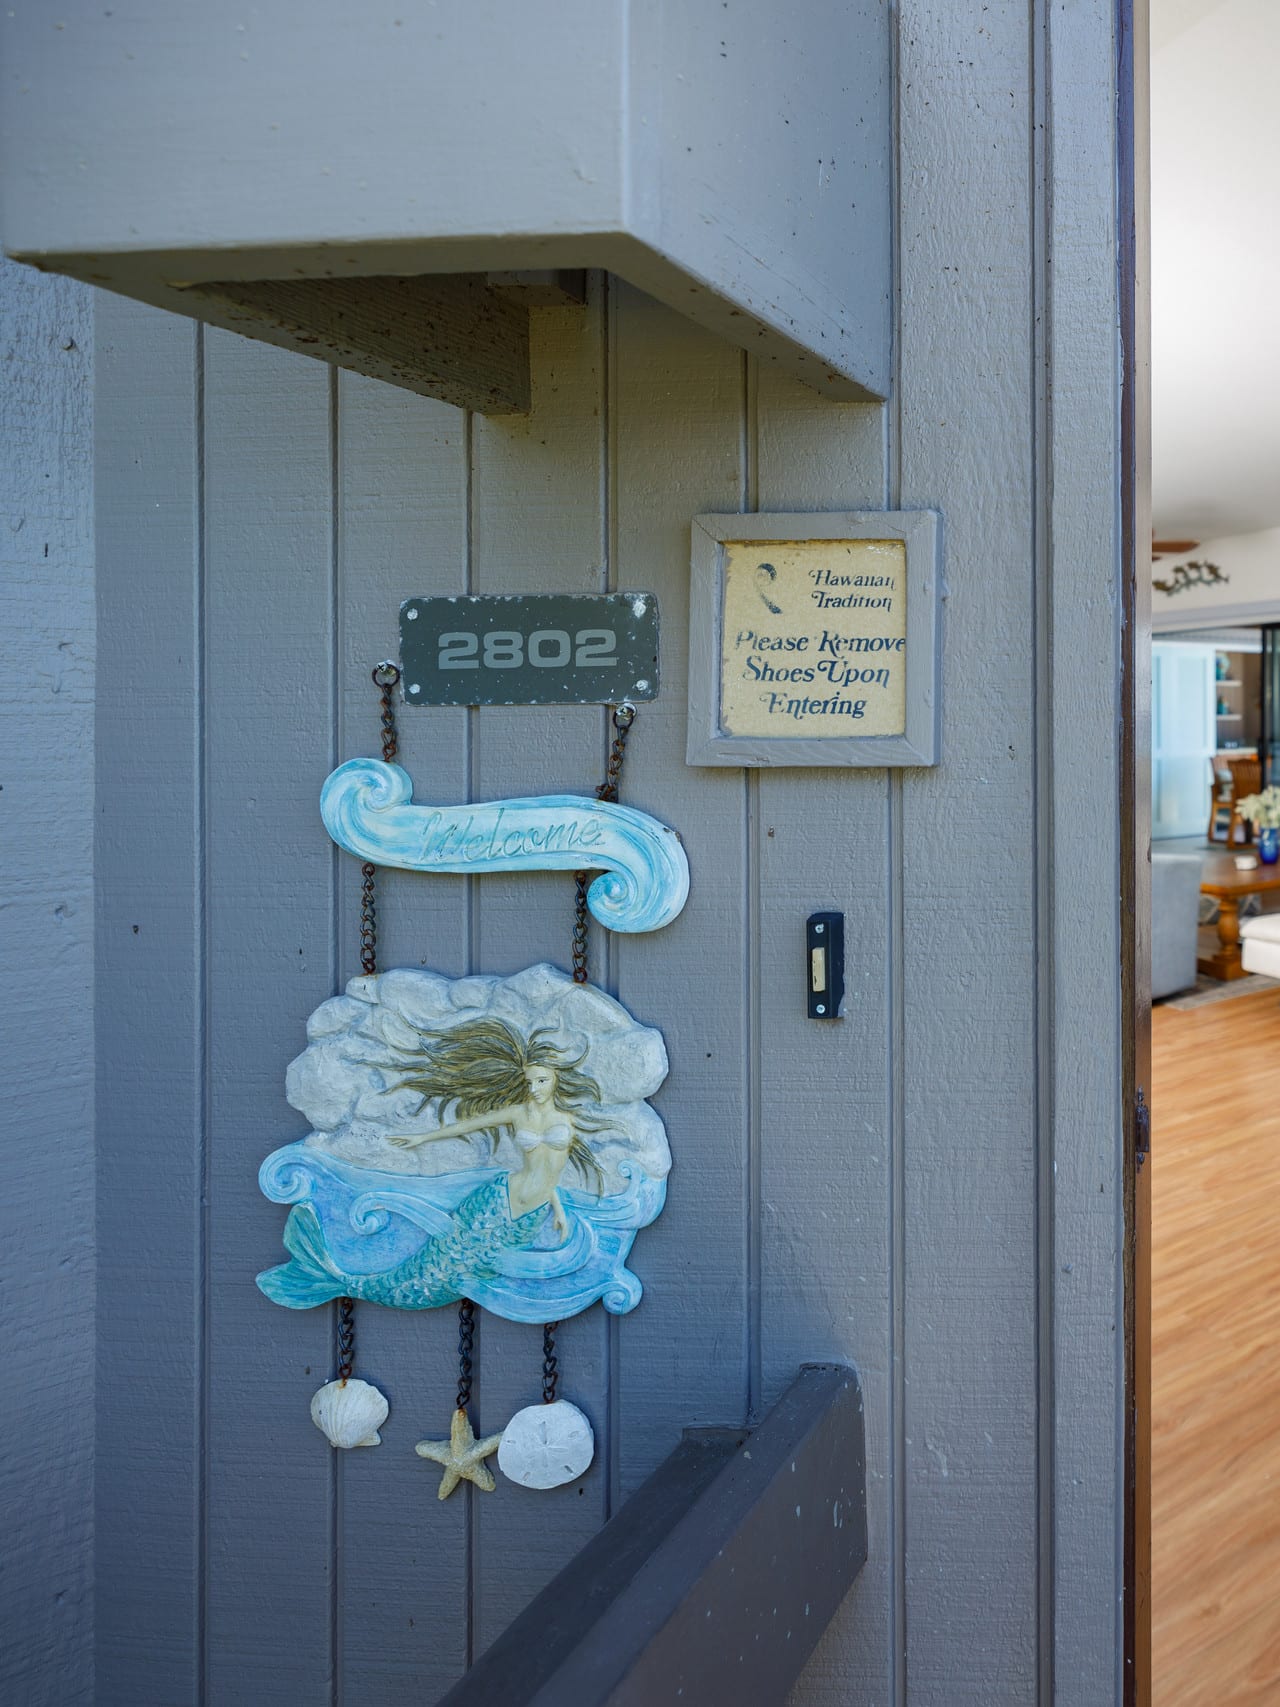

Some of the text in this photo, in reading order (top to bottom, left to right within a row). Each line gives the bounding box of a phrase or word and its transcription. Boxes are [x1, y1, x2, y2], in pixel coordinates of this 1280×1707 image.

[811, 590, 892, 612] Tradition
[438, 629, 617, 670] 2802
[735, 630, 906, 659] Please Remove
[743, 655, 890, 688] Shoes Upon
[759, 691, 867, 720] Entering
[418, 808, 606, 862] Welcome
